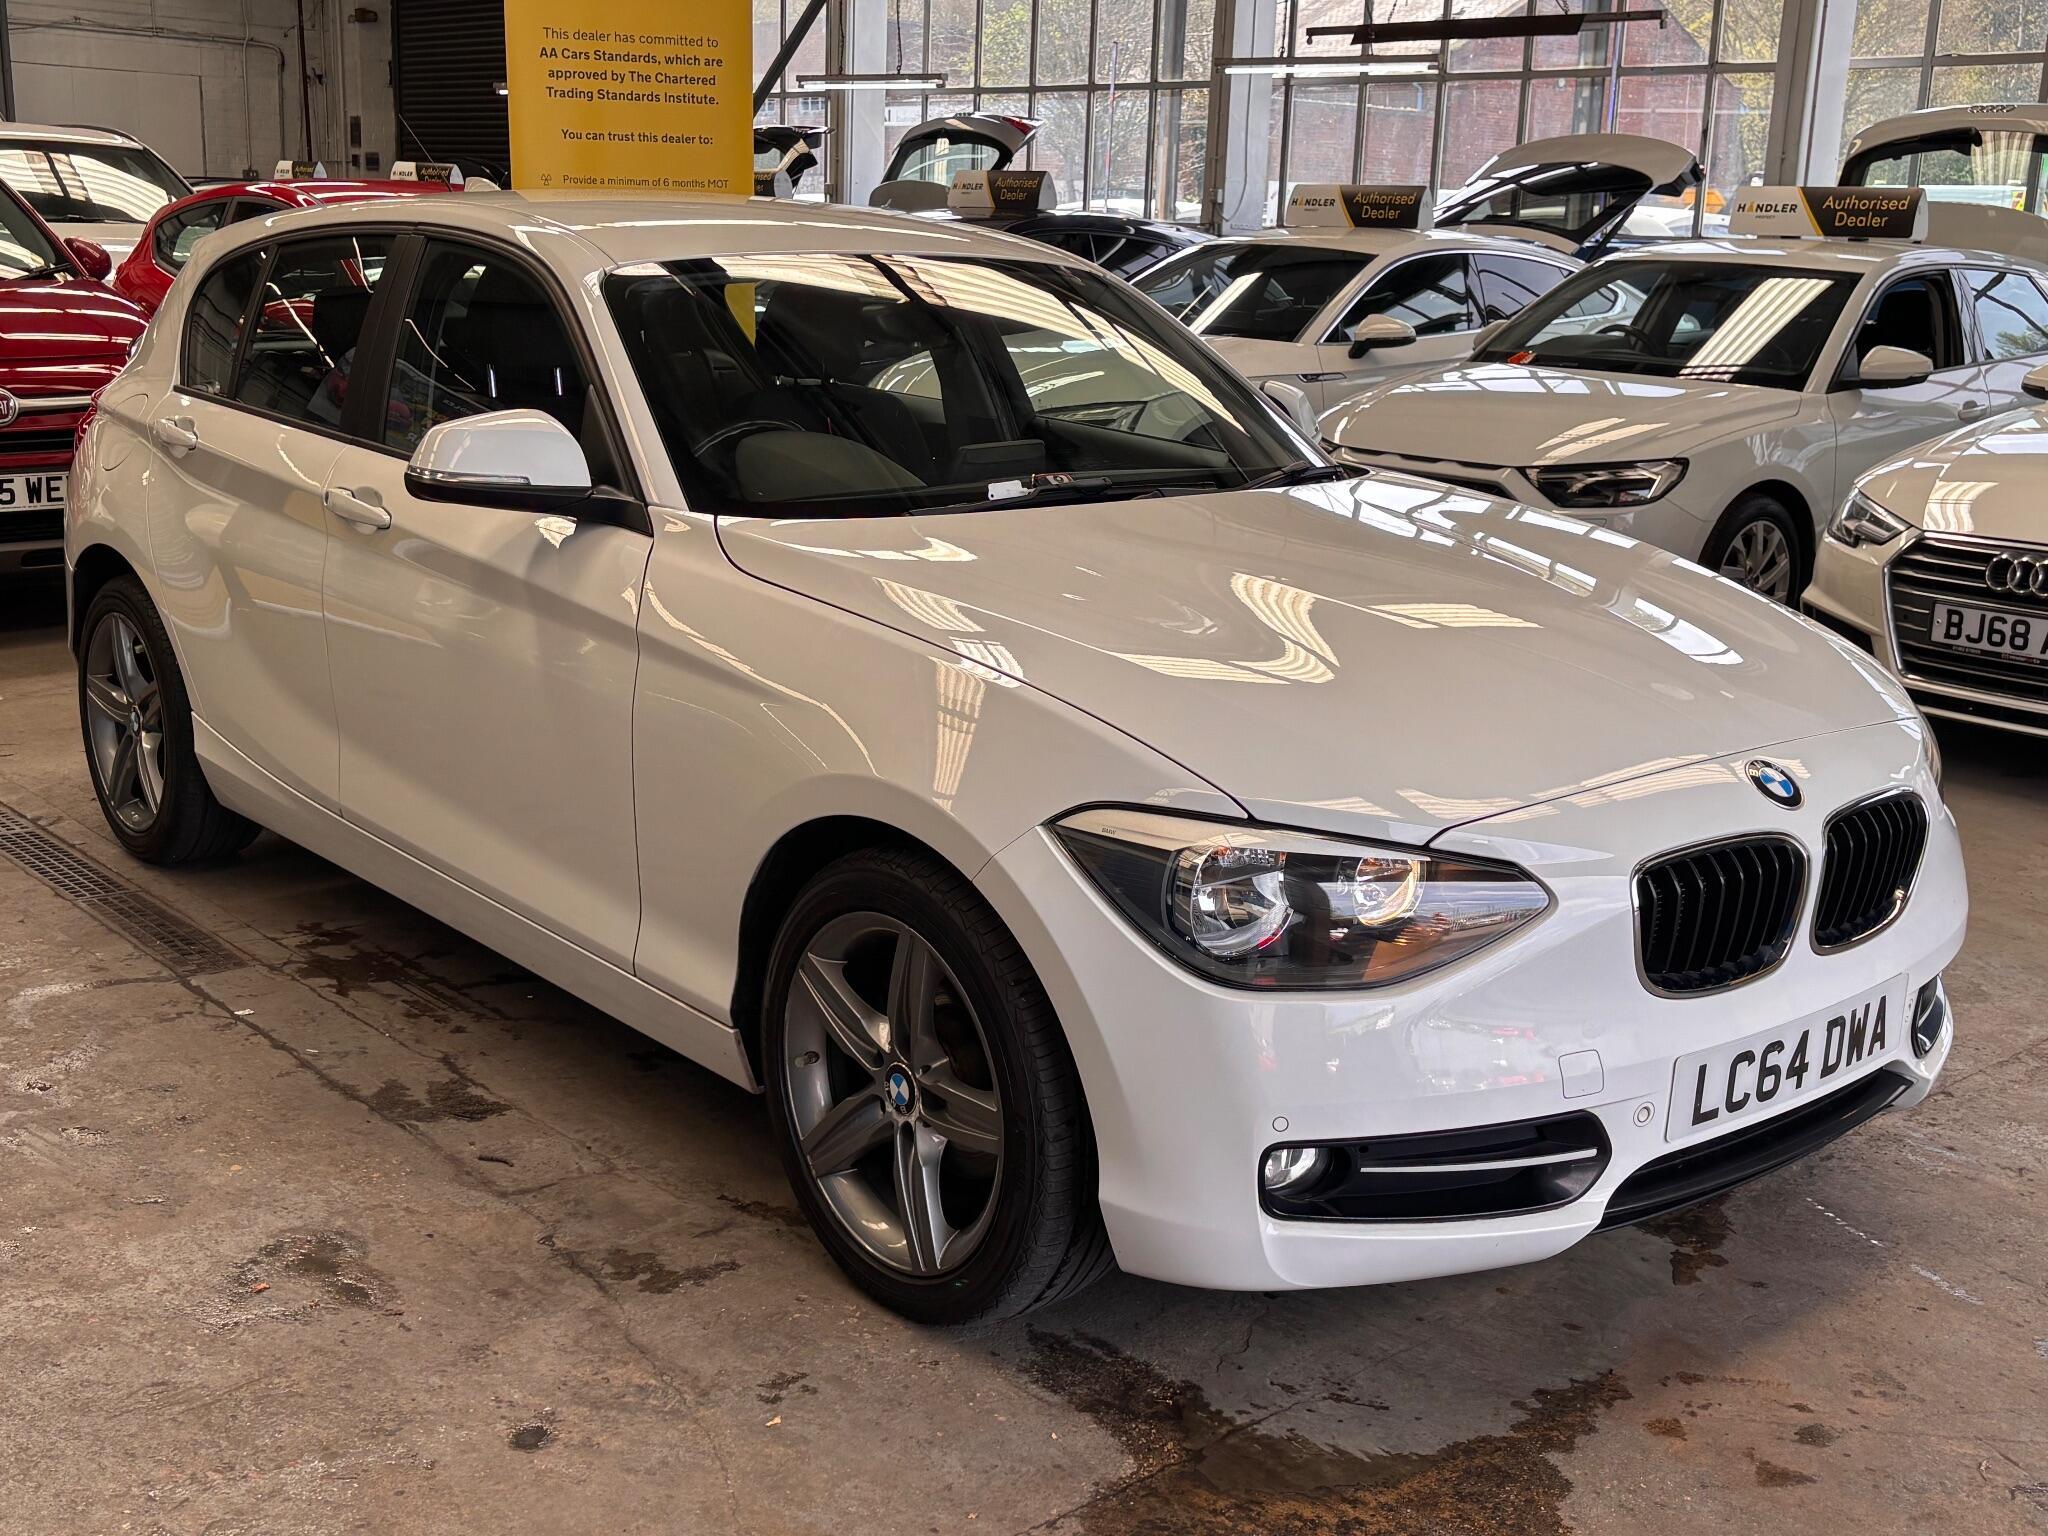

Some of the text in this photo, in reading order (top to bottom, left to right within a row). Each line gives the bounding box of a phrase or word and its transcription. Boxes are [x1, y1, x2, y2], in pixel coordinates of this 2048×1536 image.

[543, 27, 719, 48] This dealer has committed to
[539, 47, 723, 67] AA Cars Standards, which are
[548, 69, 716, 85] approved by The Chartered
[546, 86, 719, 105] Trading Standards Institute.
[561, 129, 713, 145] You can trust this dealer to:
[563, 175, 597, 185] Provide
[608, 176, 649, 187] minimum
[652, 178, 661, 187] of
[663, 178, 670, 187] 6
[672, 179, 706, 188] months
[707, 179, 729, 189] MOT
[995, 176, 1040, 188] Authorised
[1000, 188, 1027, 200] Dealer
[1353, 191, 1417, 205] Authorised
[1822, 195, 1911, 210] Authorised
[1361, 205, 1401, 219] Dealer
[1834, 211, 1889, 227] Dealer
[25, 475, 69, 504] WE
[1943, 608, 2031, 651] BJ68
[1691, 995, 1887, 1126] LC64 DWA
